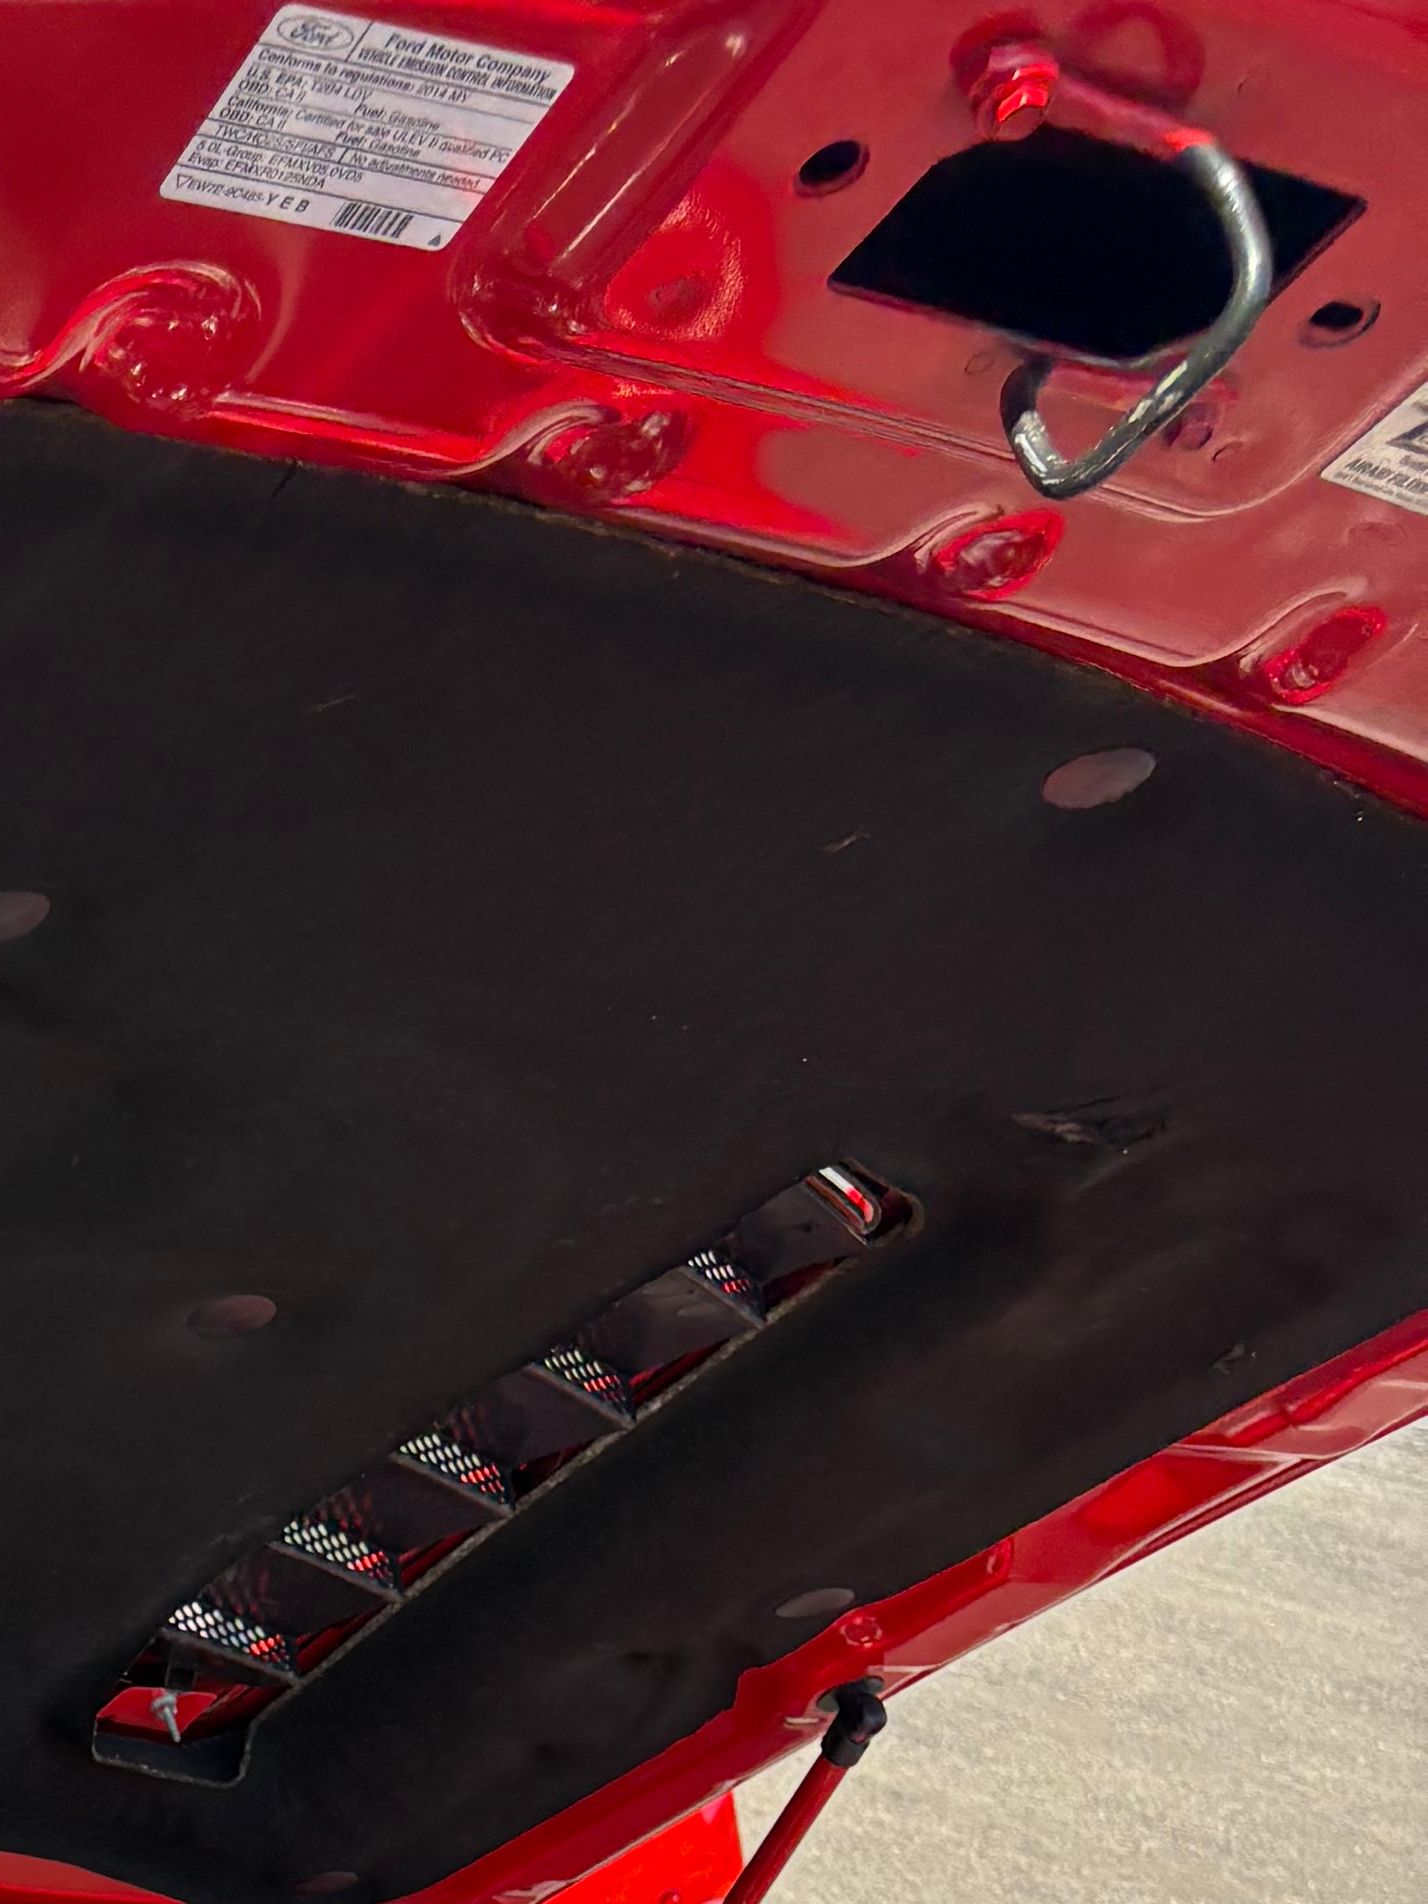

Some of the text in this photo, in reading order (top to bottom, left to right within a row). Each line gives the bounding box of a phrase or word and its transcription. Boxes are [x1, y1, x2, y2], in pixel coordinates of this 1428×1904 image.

[355, 46, 559, 101] VEHICLE EMISSION CONTROL INFORMATION
[382, 33, 554, 87] Ford Motor Company
[255, 47, 472, 104] Conforms to regulations: 2014 MY
[224, 95, 295, 119] California:
[351, 103, 443, 133] Fuel: Gasoline
[332, 131, 423, 159] Fuel: Gasoline
[348, 153, 369, 165] No
